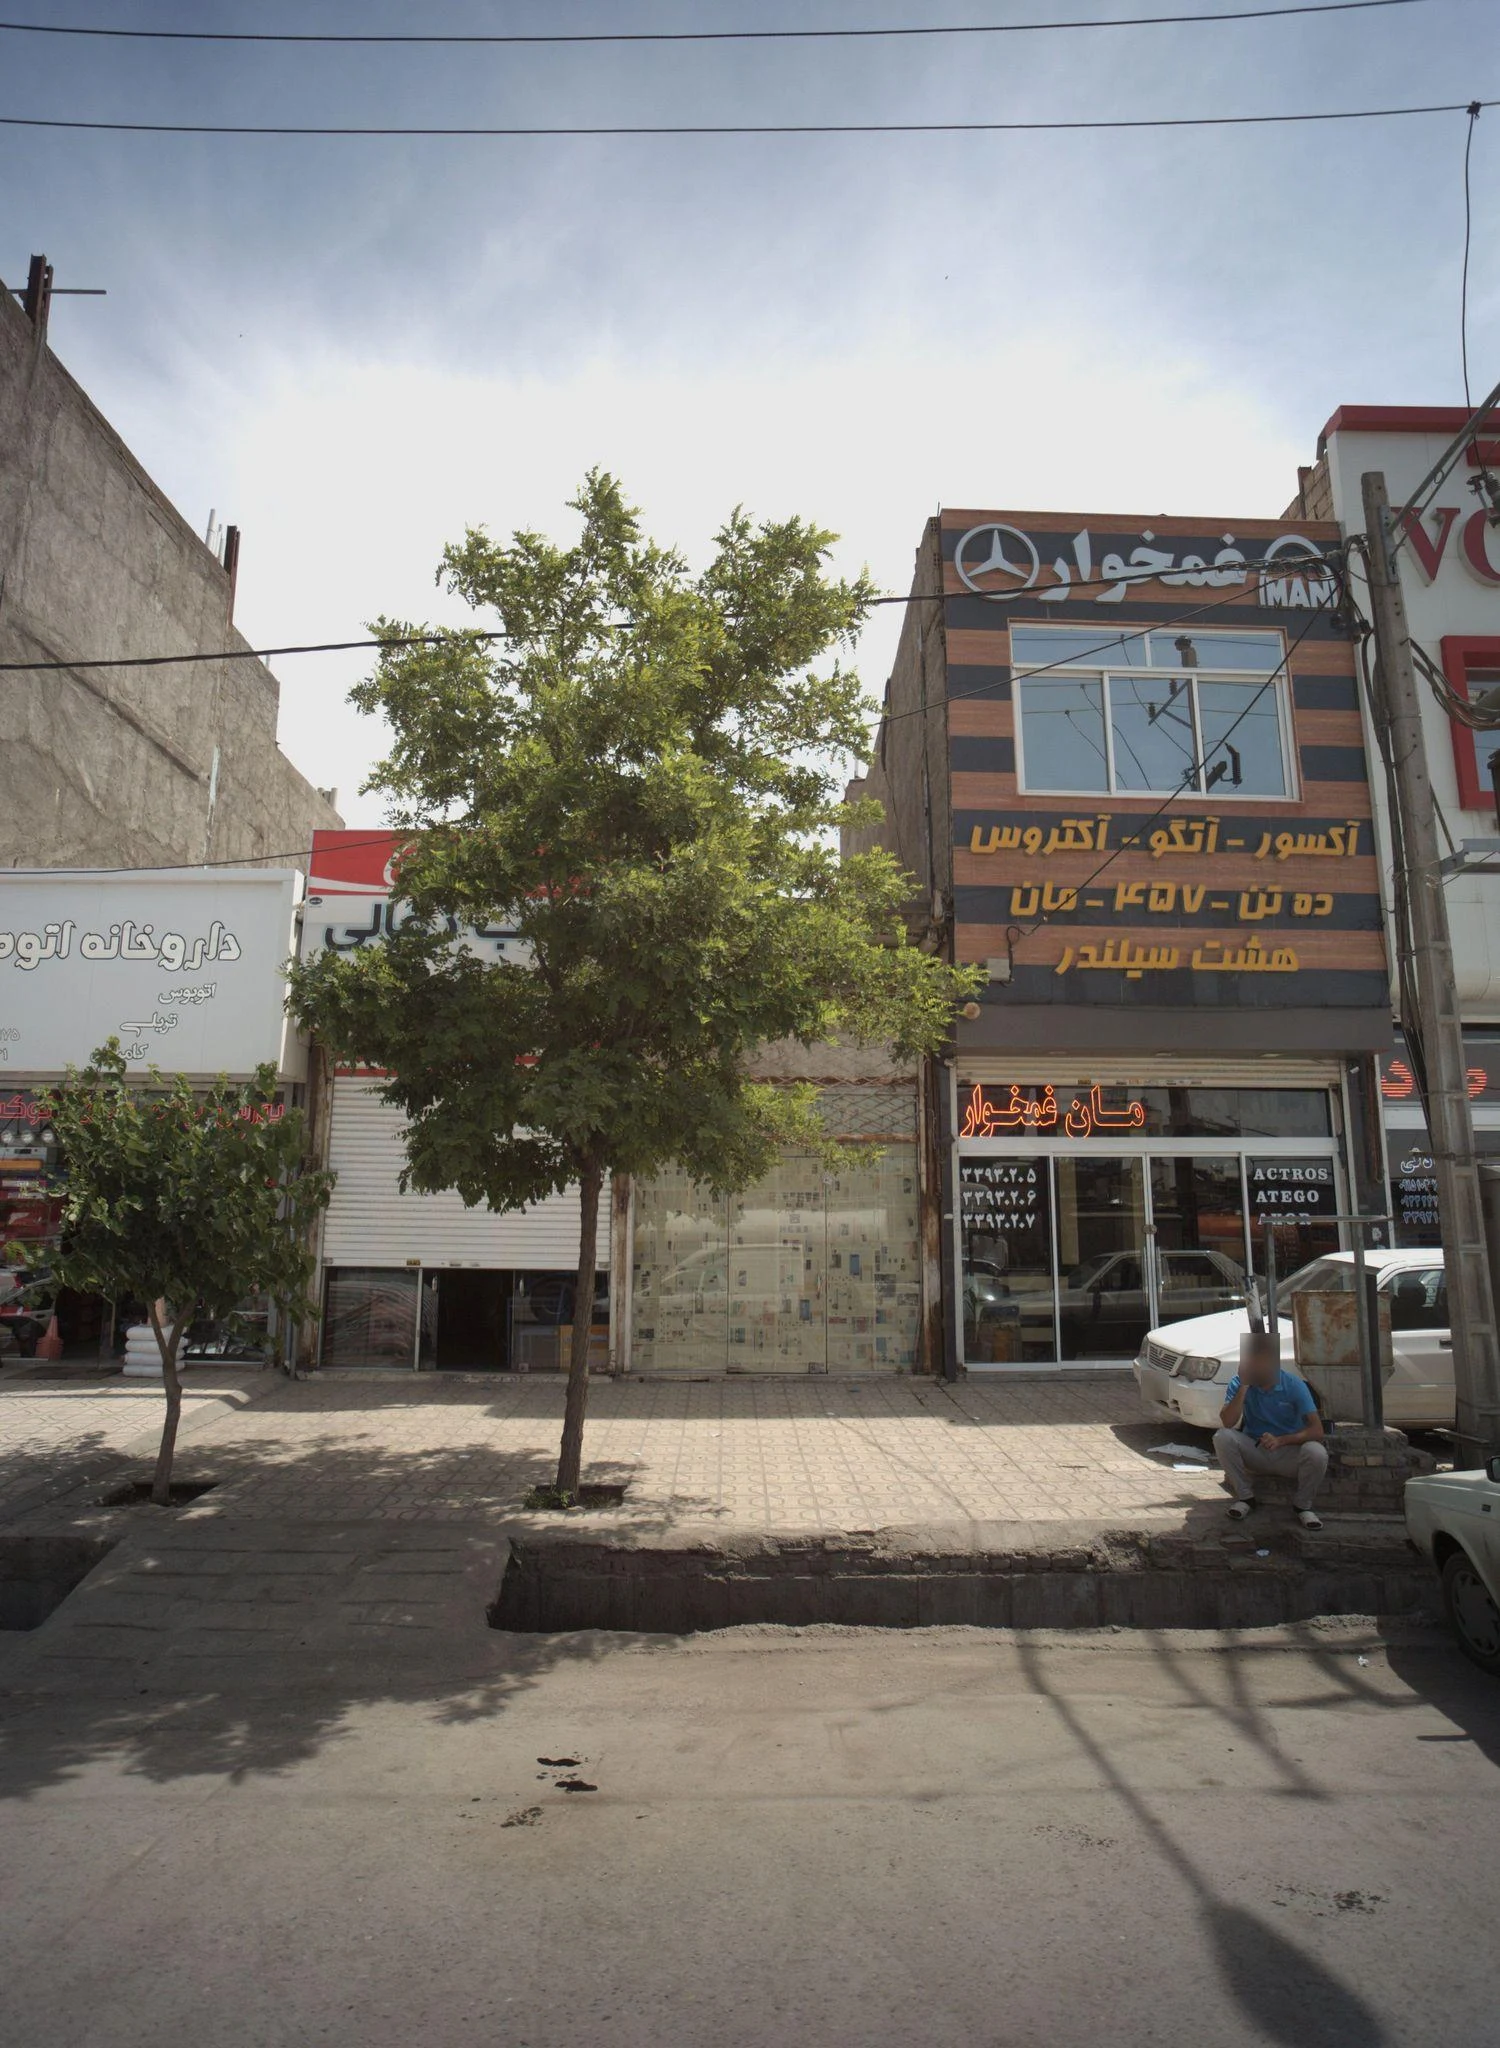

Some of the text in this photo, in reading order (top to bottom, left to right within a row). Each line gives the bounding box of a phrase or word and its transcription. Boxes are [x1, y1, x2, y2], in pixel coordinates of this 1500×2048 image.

[1039, 528, 1247, 602] غمخوار
[1266, 575, 1331, 609] MAN
[970, 814, 1112, 856] آکتروس
[1149, 816, 1220, 860] آتگو
[1254, 820, 1361, 861] آکسور
[1009, 879, 1079, 918] مان
[1113, 881, 1207, 914] ۴۵۷
[1238, 884, 1283, 921] تن
[1291, 890, 1334, 917] ده
[79, 920, 243, 972] داروخانه
[1054, 934, 1301, 981] هشت سیلندر
[157, 982, 218, 1005] اتوبوس
[119, 1011, 179, 1037] تریلی
[959, 1083, 1145, 1139] مان غمخوار
[961, 1167, 1037, 1184] ۳۳۹۳۰۲۰۵
[1253, 1167, 1329, 1181] ACTROS
[962, 1190, 1037, 1206] ۳۳۹۳۰۲۰۶
[1255, 1189, 1320, 1203] ATEGO
[962, 1213, 1036, 1229] ۳۳۹۳۰۲۰۷
